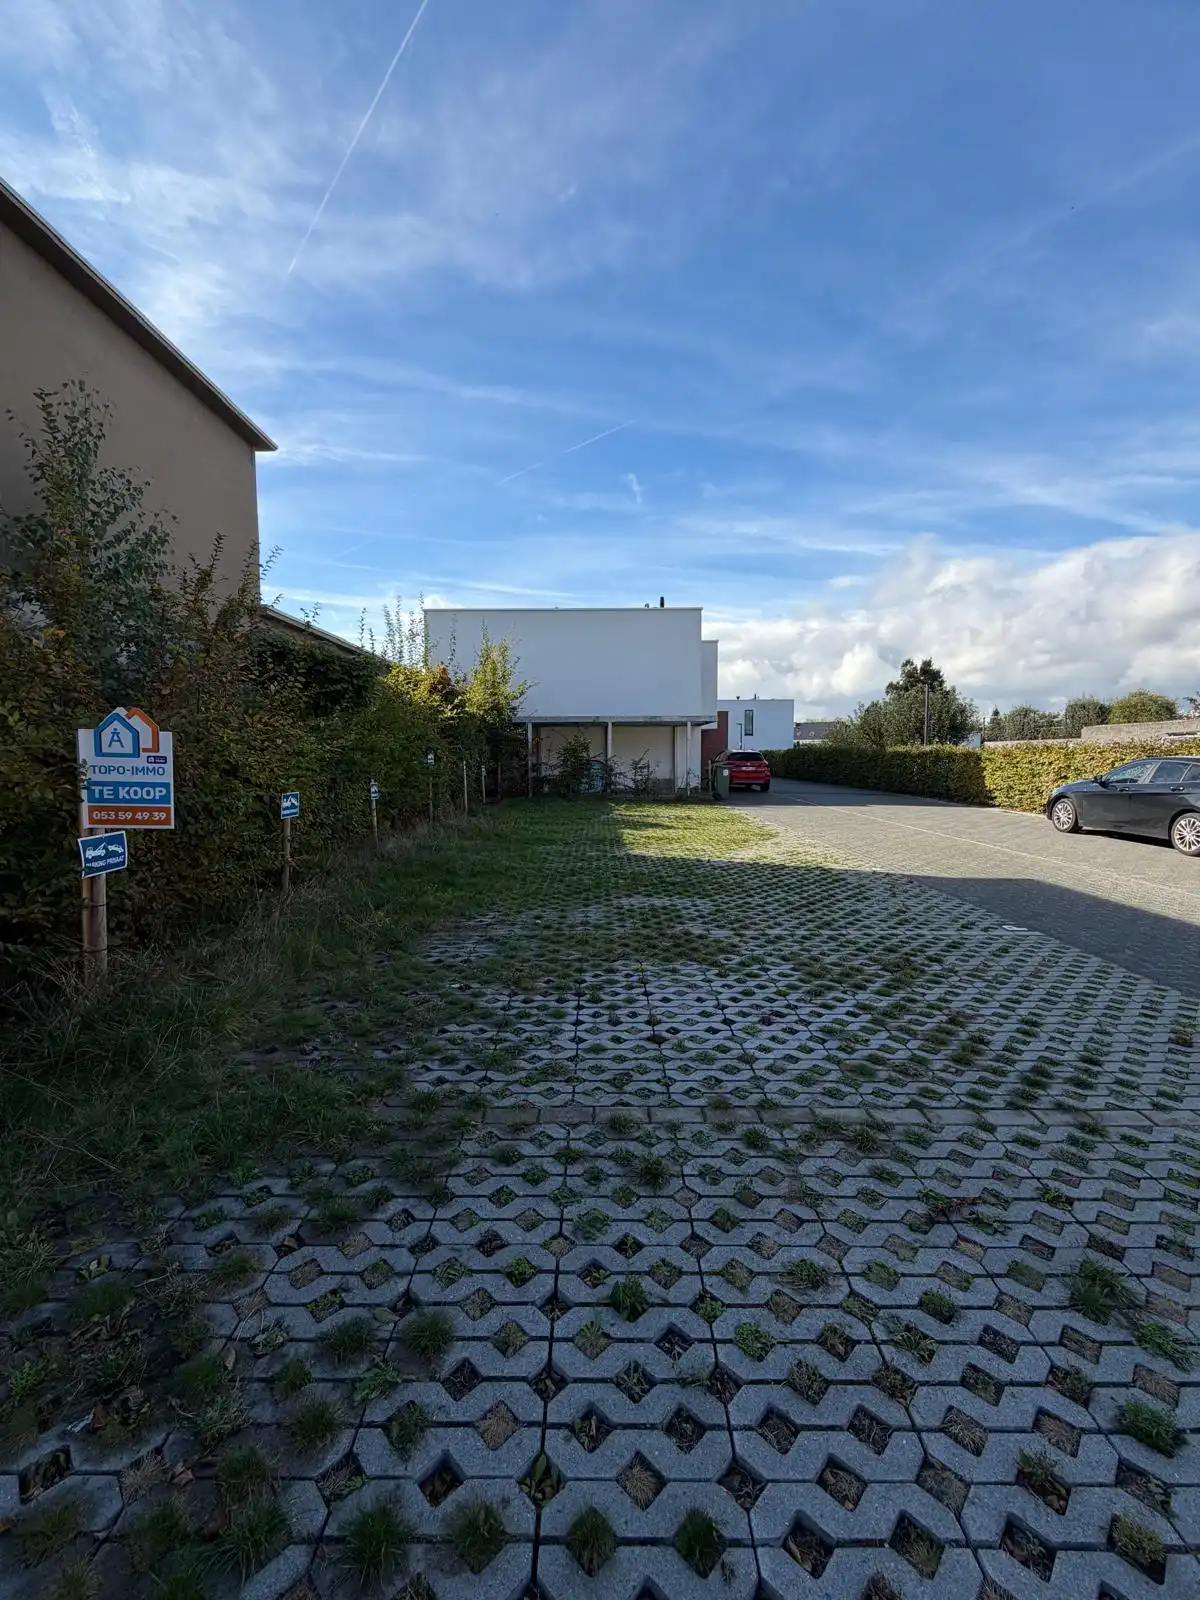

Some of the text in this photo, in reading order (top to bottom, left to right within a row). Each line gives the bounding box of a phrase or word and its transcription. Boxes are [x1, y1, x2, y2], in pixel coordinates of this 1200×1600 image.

[90, 764, 166, 776] TOPO-IMMO
[91, 785, 167, 800] TE KOOP
[92, 811, 167, 821] 053 59 49 39
